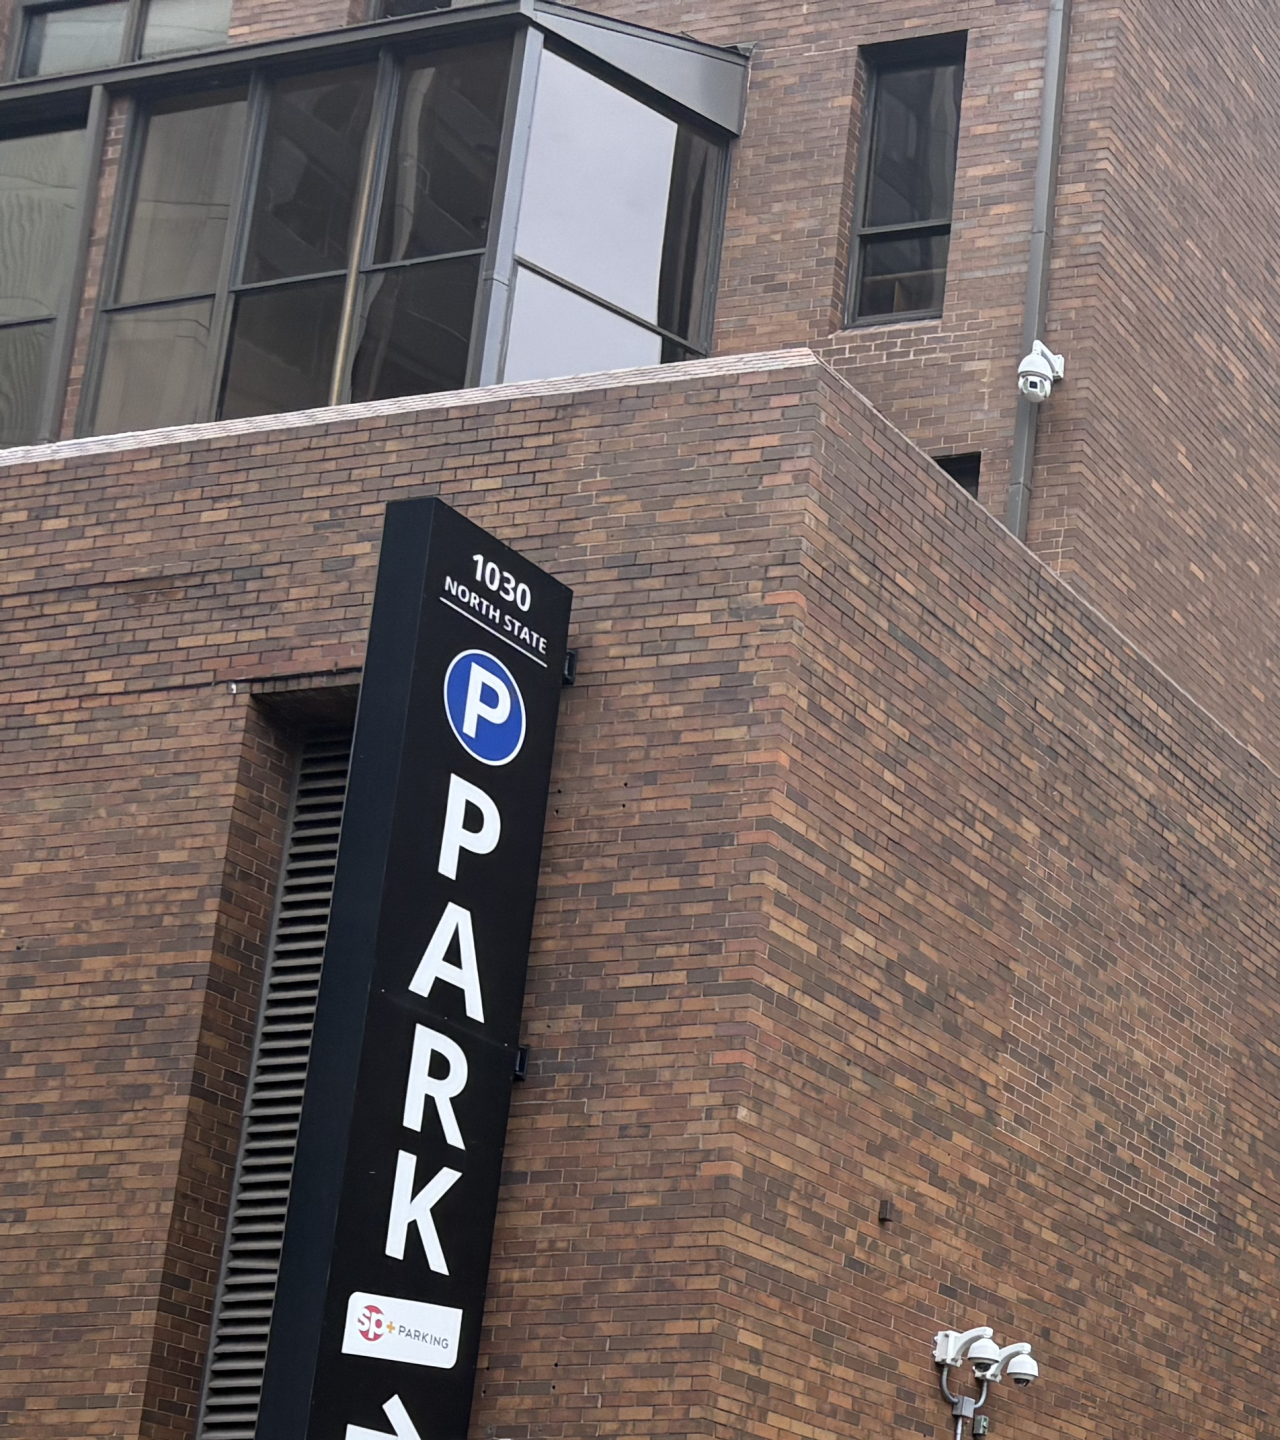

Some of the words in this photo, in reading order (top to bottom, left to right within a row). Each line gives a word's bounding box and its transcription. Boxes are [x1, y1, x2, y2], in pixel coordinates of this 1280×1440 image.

[444, 575, 500, 623] NORTH
[504, 614, 547, 655] STATE
[472, 553, 531, 612] 1030
[462, 661, 511, 739] P
[385, 773, 501, 1276] PARK
[398, 1325, 449, 1350] PARKING
